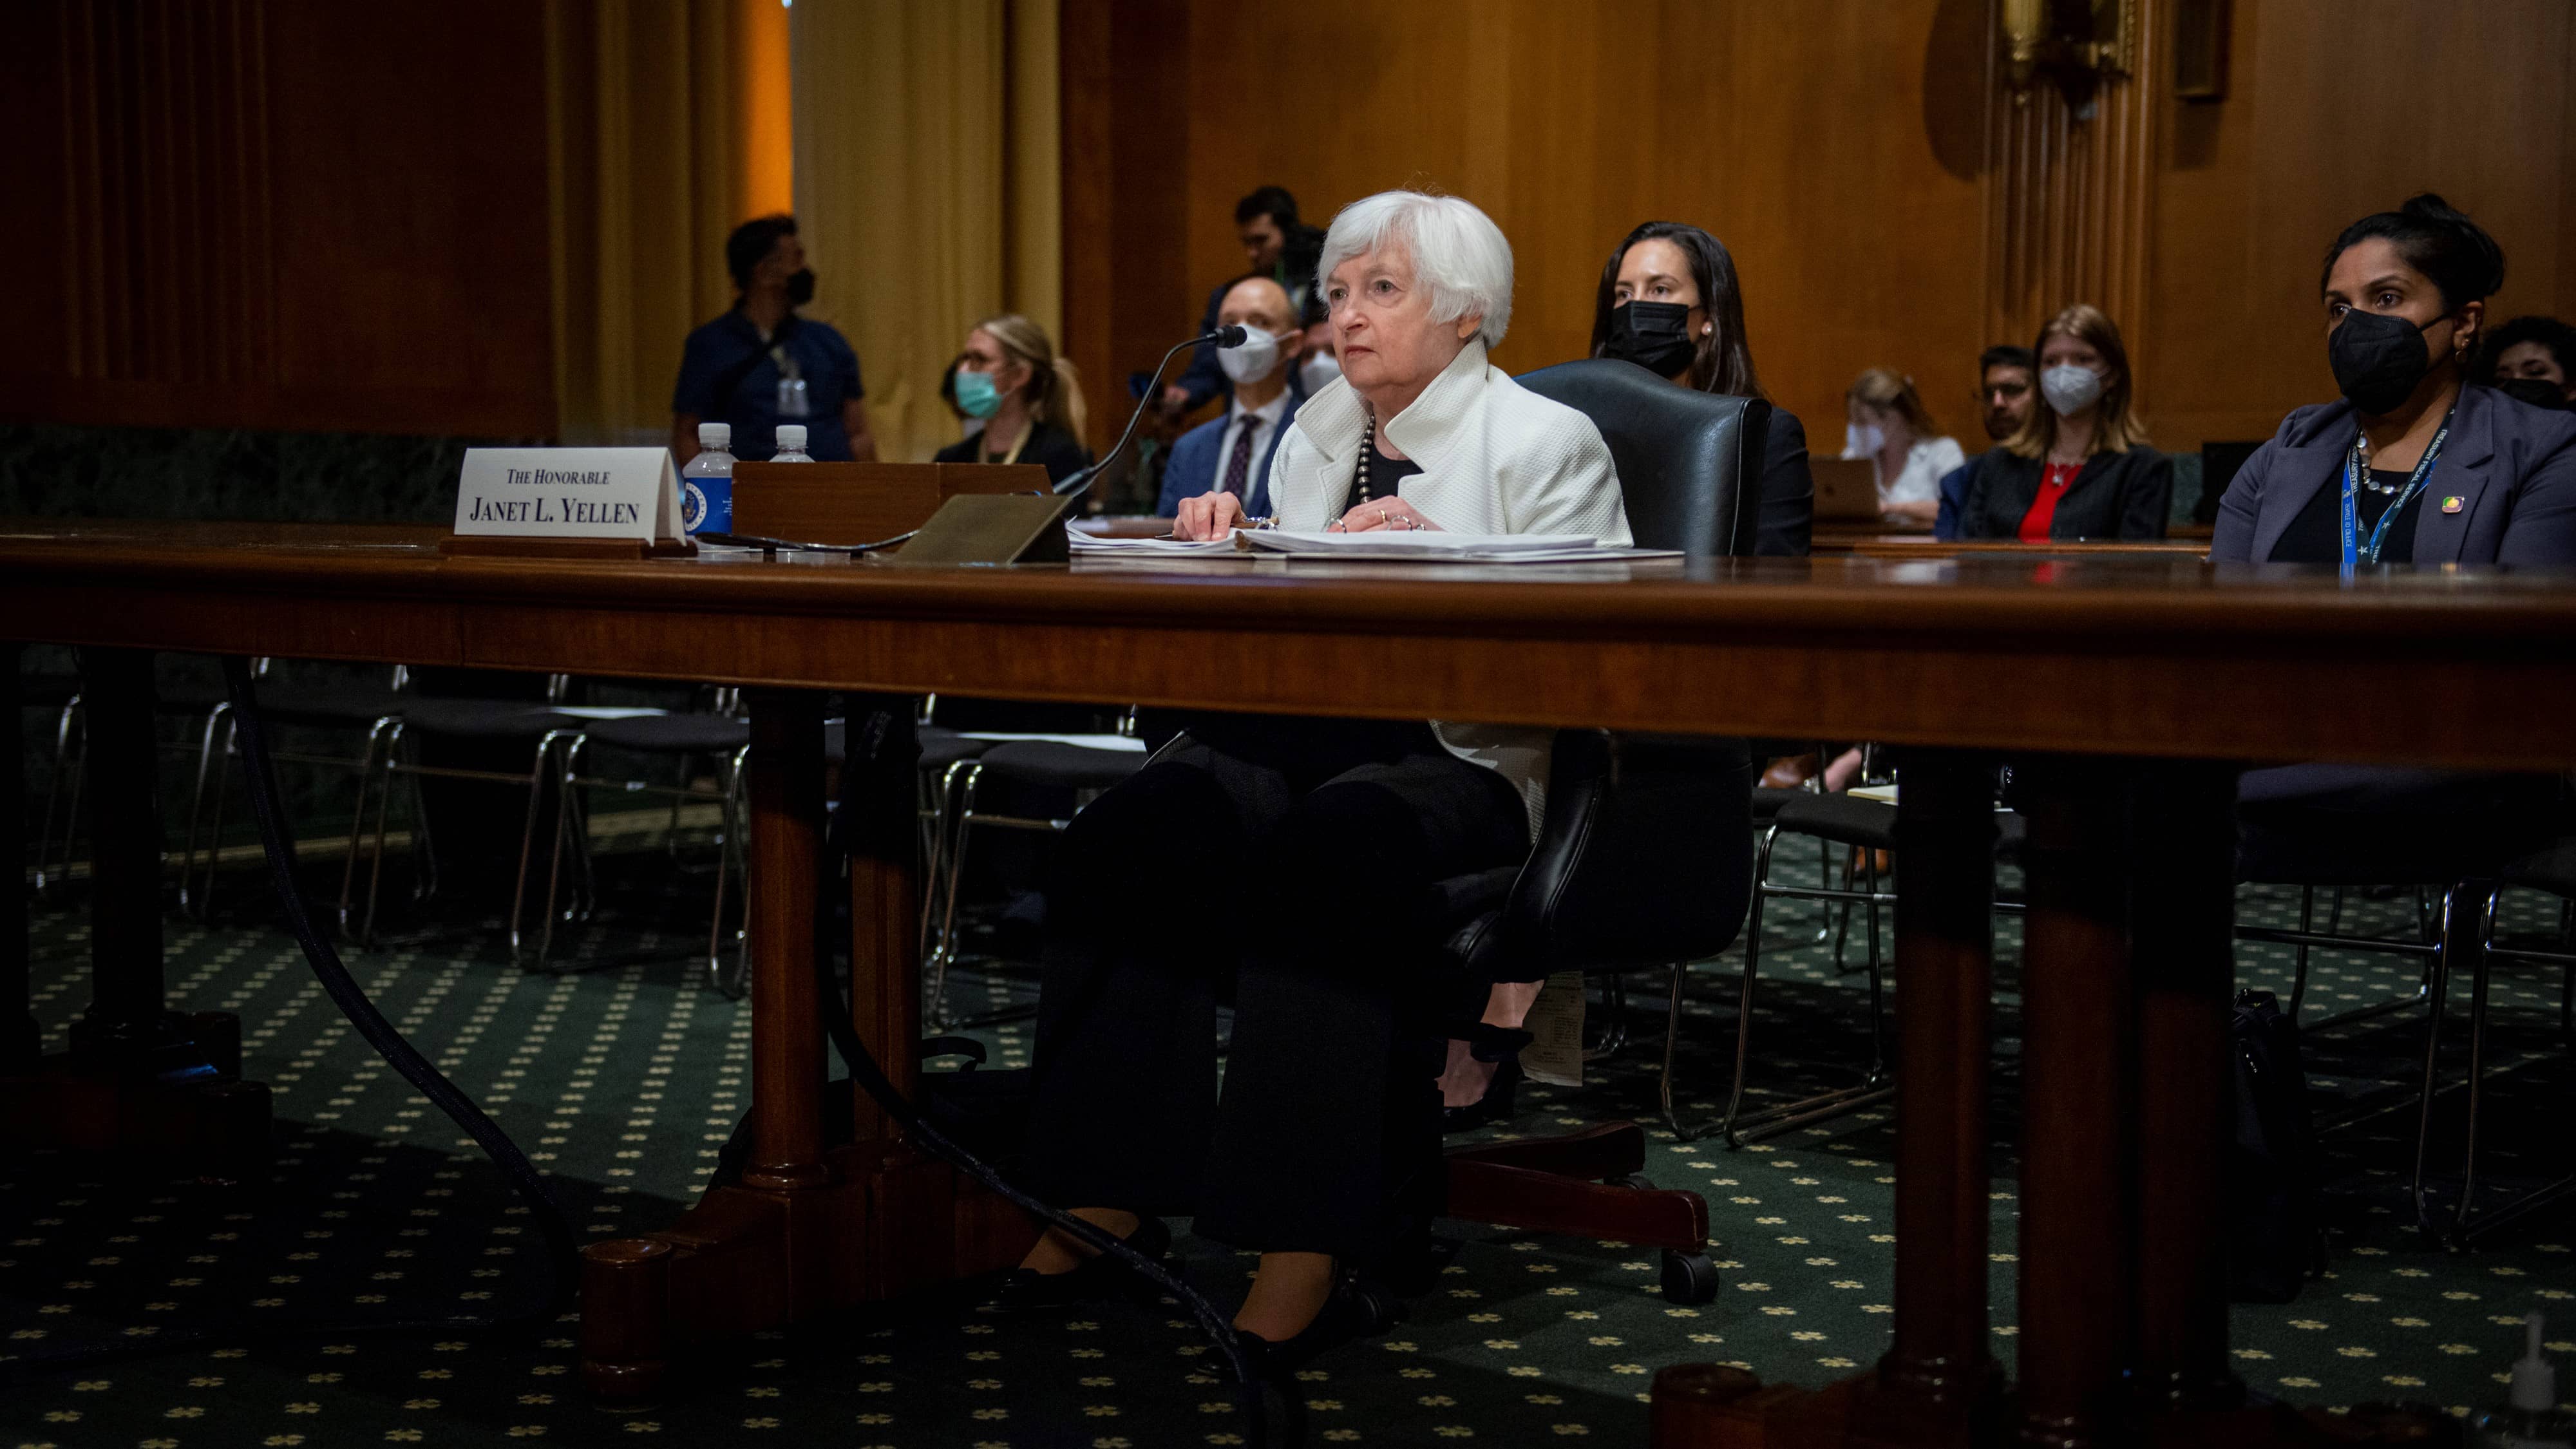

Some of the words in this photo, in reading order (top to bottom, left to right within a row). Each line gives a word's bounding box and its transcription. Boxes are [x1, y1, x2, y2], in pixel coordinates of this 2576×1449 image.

[2425, 429, 2447, 460] TREASURY
[534, 469, 610, 484] HONORABLE
[2350, 462, 2358, 493] TREASURY
[2410, 460, 2429, 481] FISCAL
[2394, 482, 2415, 509] SERVICE
[469, 497, 531, 521] JANET
[535, 498, 554, 522] L.
[561, 498, 639, 524] YELLEN
